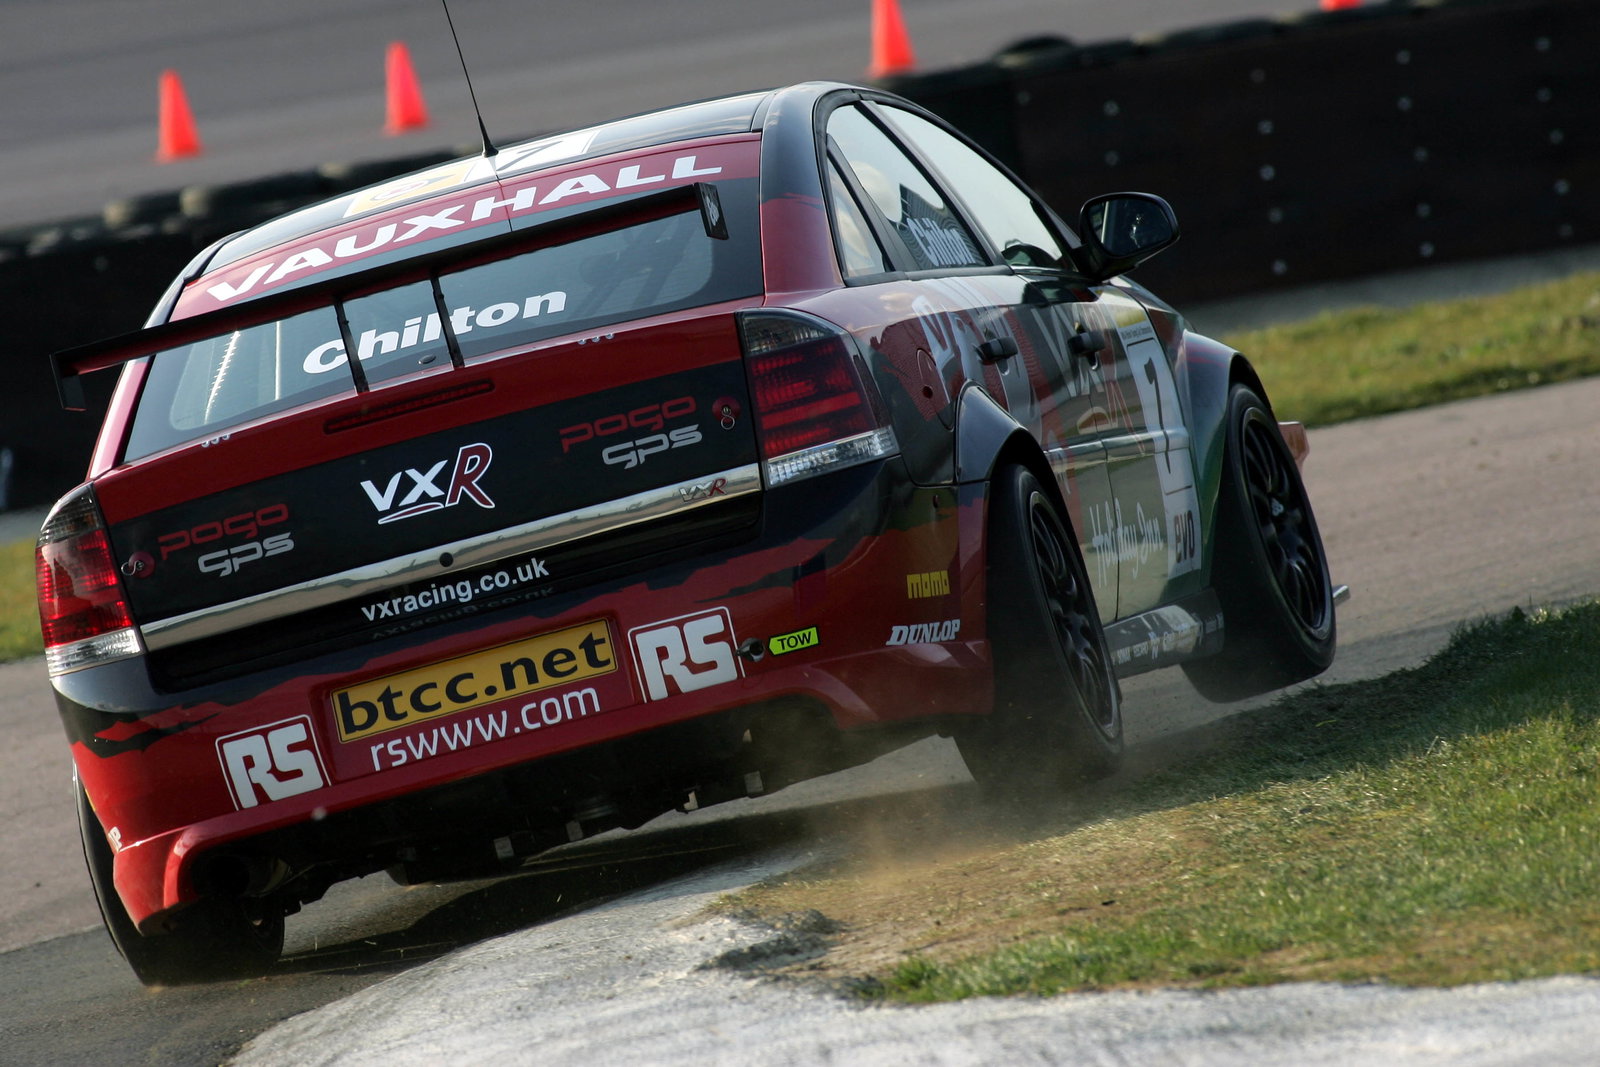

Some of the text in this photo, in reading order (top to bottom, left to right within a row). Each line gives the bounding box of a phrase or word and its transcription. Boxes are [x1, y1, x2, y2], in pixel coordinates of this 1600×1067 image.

[207, 155, 723, 301] VAUXHALL
[303, 290, 567, 375] Chilton
[360, 442, 495, 512] VXR
[679, 478, 728, 502] VXR
[361, 558, 549, 622] vxracing.co.uk
[635, 614, 738, 701] RS
[777, 631, 812, 651] TOW
[885, 619, 961, 646] DUNLOP
[338, 631, 611, 735] btcc.net
[222, 723, 324, 808] RS
[371, 687, 601, 771] rswww.com
